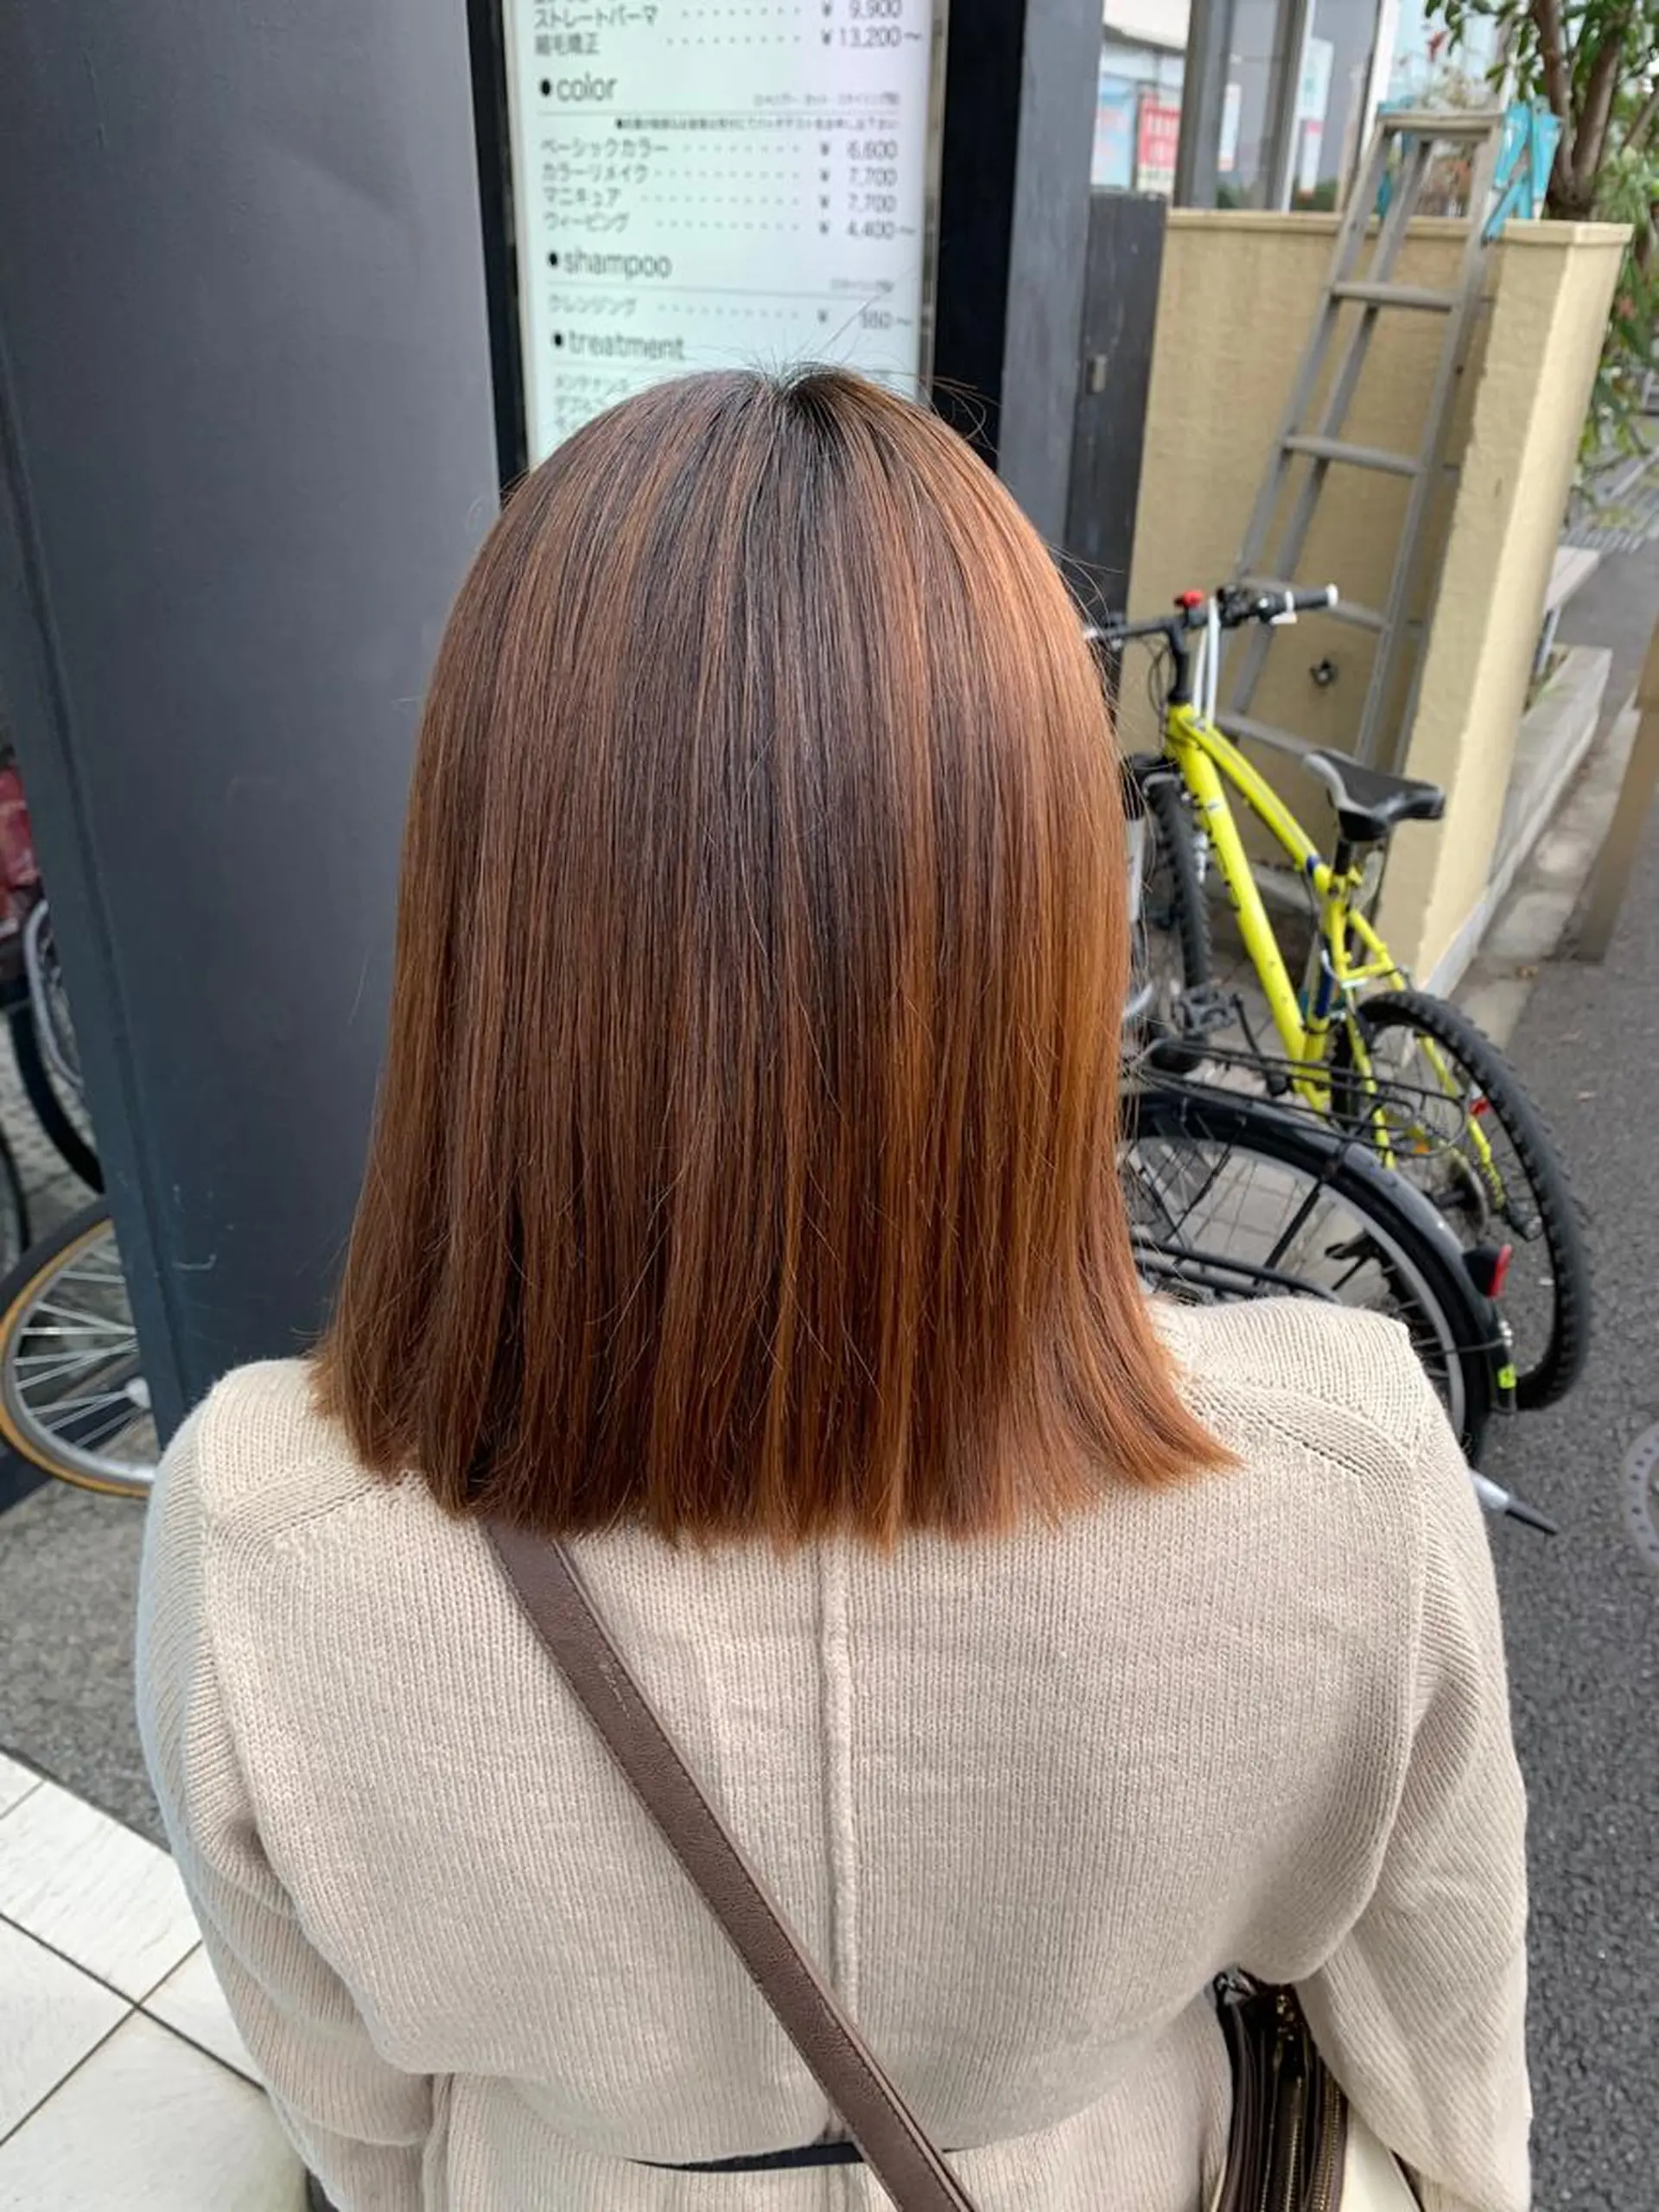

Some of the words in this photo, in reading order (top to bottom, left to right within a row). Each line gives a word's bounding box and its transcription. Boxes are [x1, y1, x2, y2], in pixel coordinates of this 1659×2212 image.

[535, 4, 658, 29] ストレートパーマ
[556, 71, 618, 101] color
[540, 137, 669, 157] ベーシックカラー
[563, 246, 673, 281] shampoo
[568, 328, 684, 360] treatment
